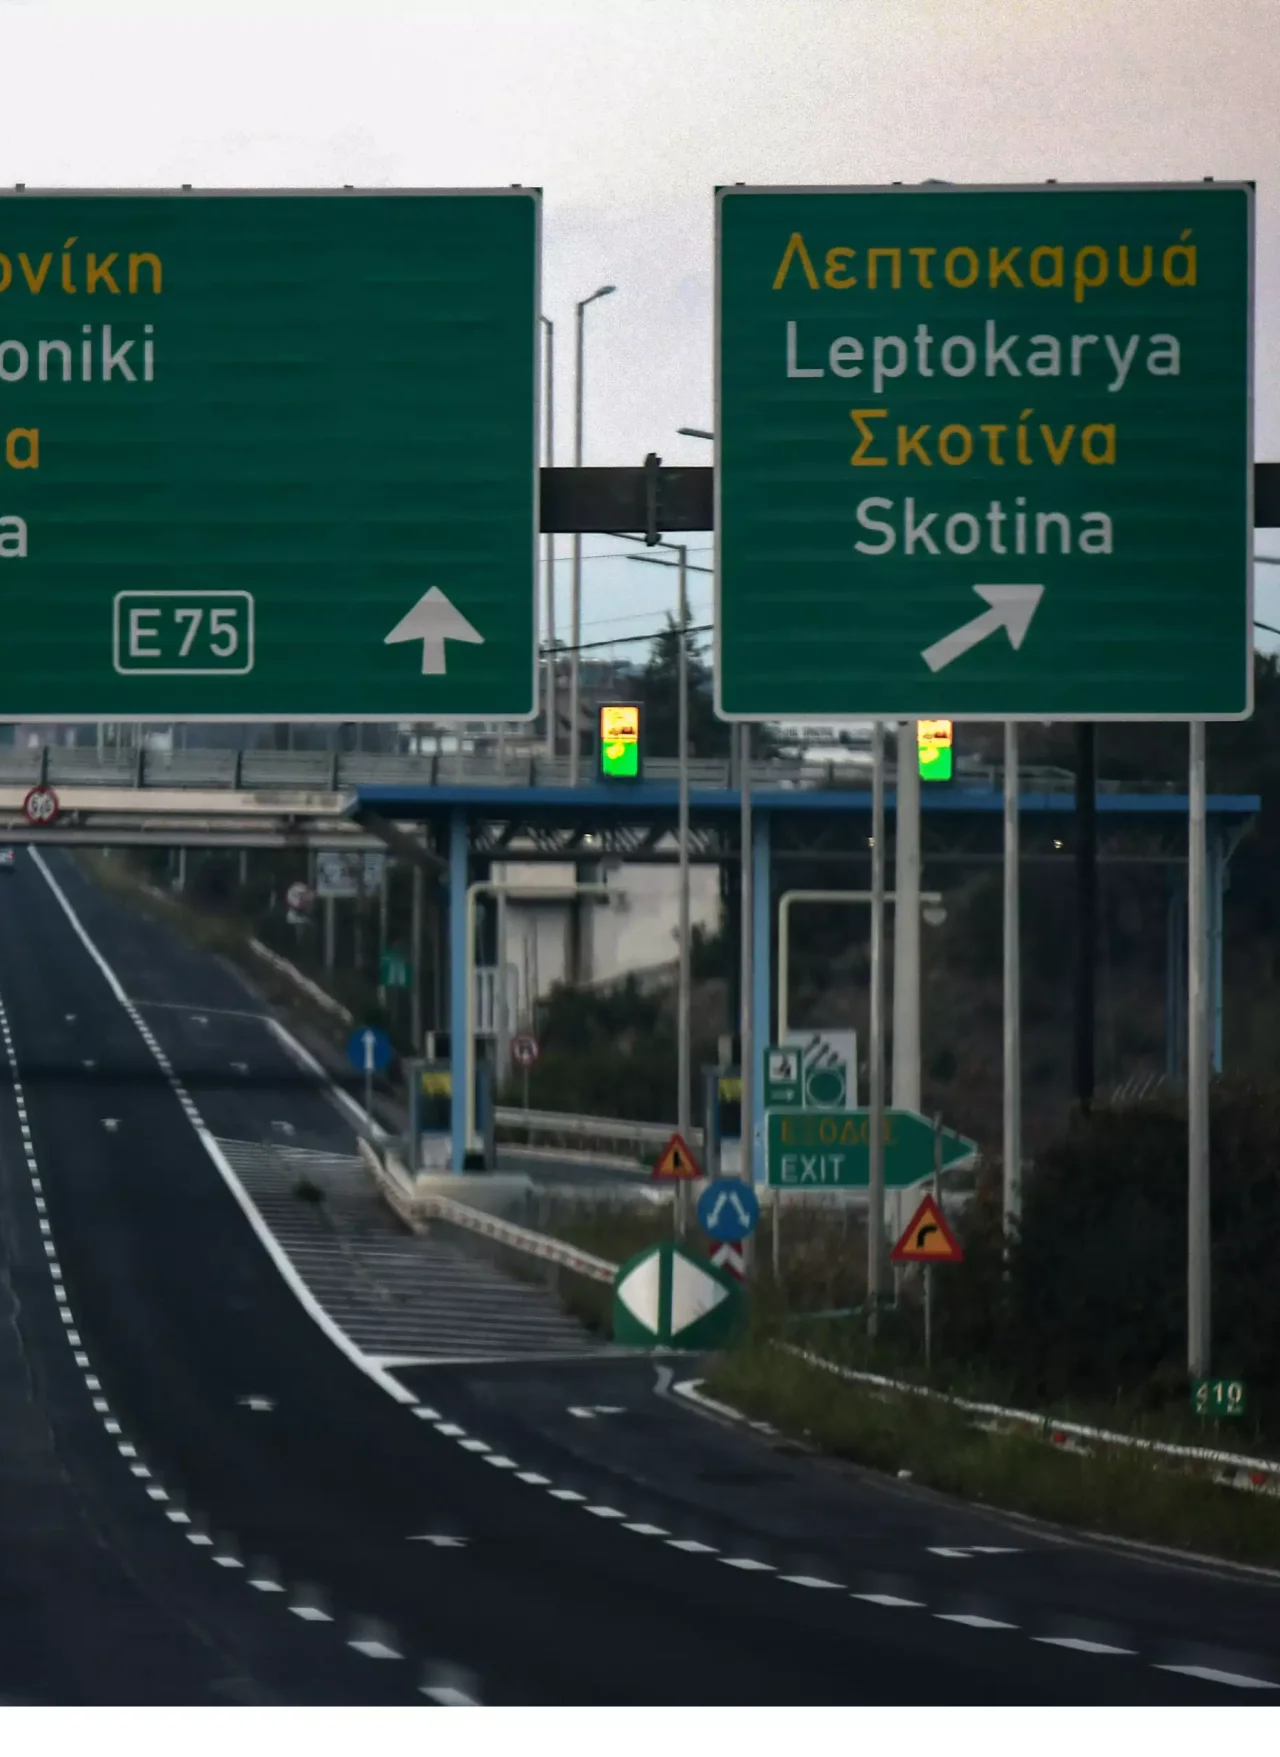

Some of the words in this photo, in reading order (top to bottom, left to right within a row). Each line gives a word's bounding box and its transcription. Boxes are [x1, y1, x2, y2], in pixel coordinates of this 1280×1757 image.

[772, 229, 1197, 303] Λεπτοκαρυά
[786, 320, 1180, 394] Leptokarya
[849, 407, 1117, 467] Σκοτίνα
[853, 496, 1113, 556] Skotina
[129, 608, 162, 657] E
[174, 608, 239, 658] 75
[781, 1153, 846, 1183] EXIT
